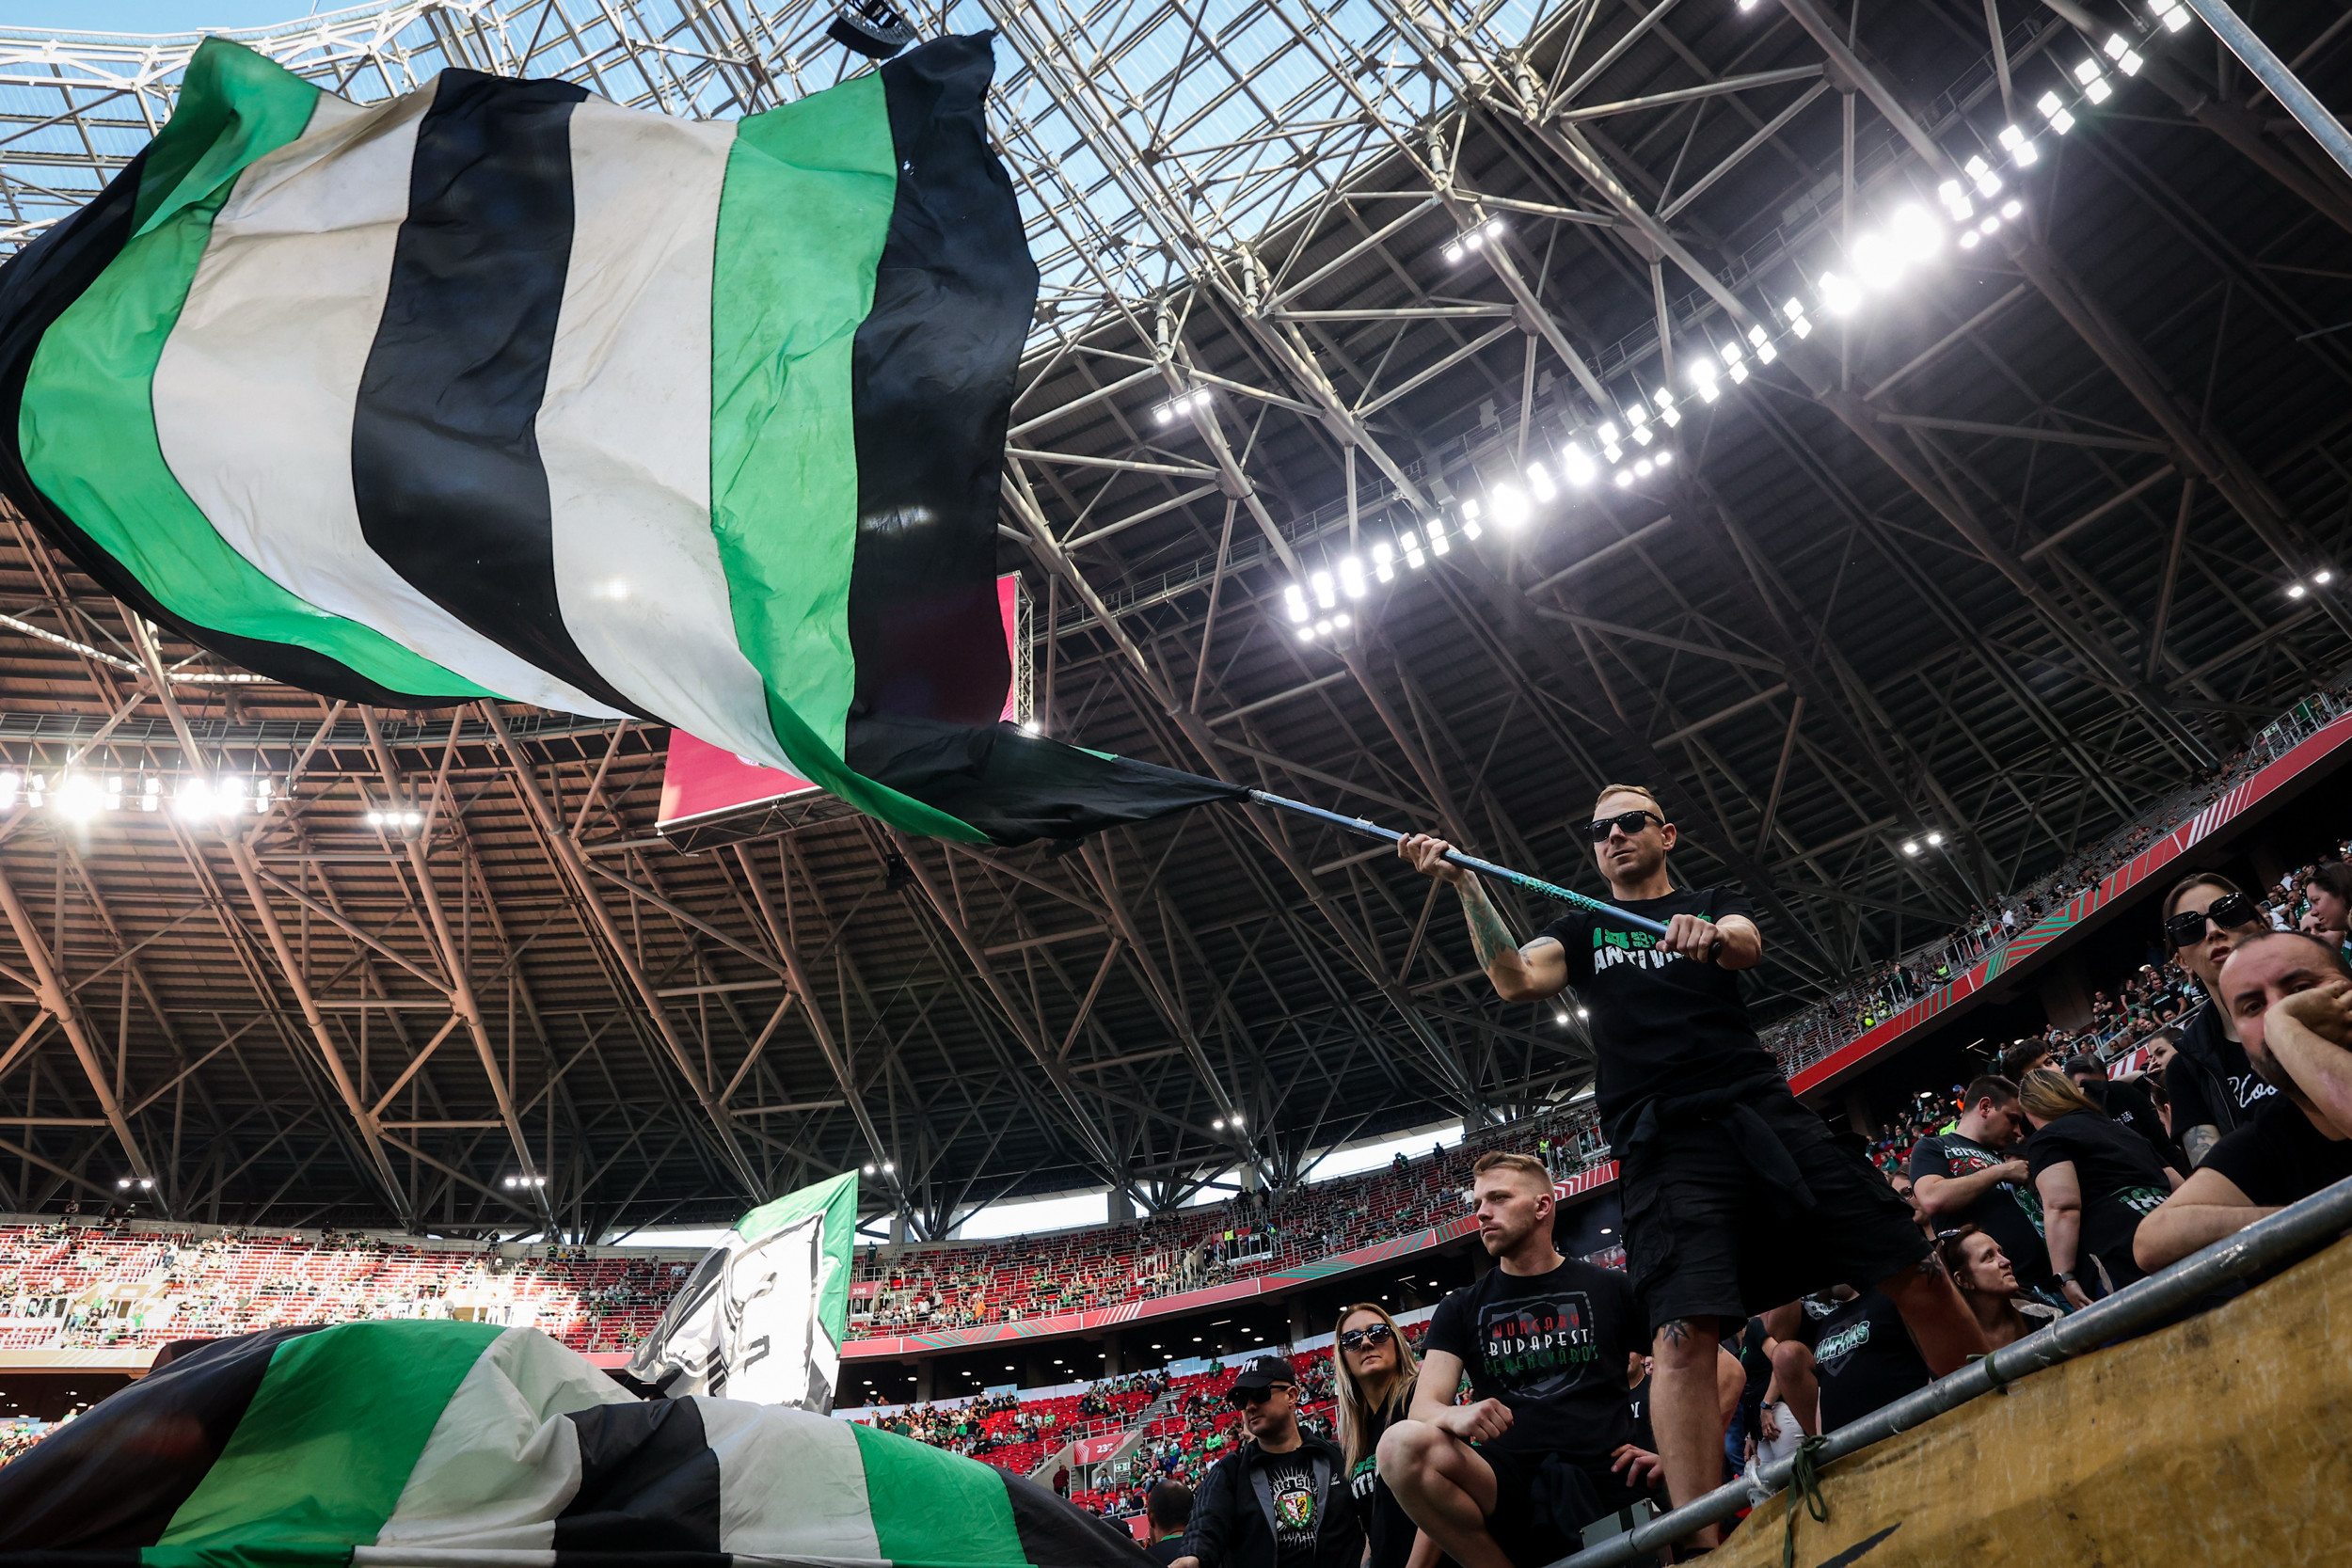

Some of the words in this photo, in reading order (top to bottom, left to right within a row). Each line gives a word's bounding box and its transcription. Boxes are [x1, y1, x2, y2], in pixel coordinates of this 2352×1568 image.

[1594, 945, 1647, 975] ANTI
[1493, 1313, 1580, 1338] HUNGARY
[1488, 1328, 1589, 1356] BUDAPEST
[1483, 1344, 1599, 1374] FERENCVÁROS
